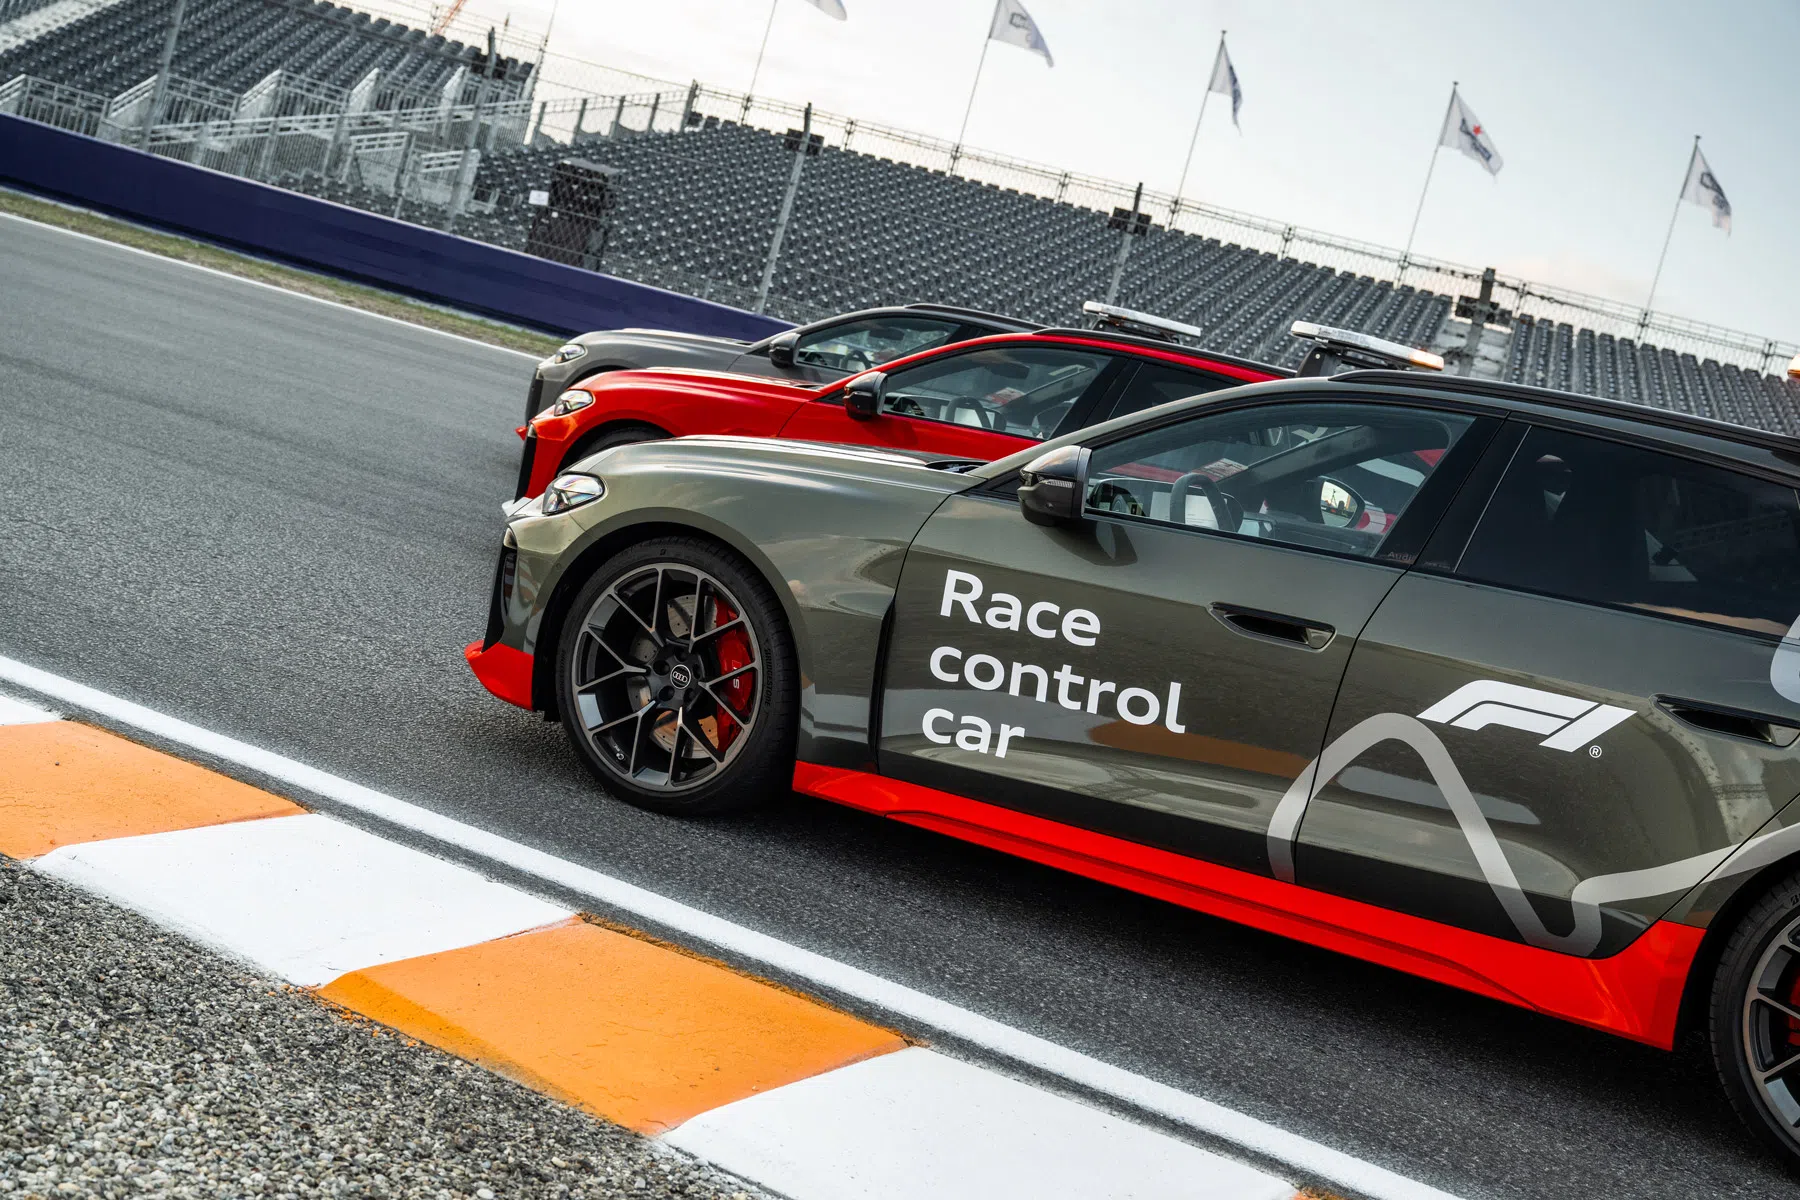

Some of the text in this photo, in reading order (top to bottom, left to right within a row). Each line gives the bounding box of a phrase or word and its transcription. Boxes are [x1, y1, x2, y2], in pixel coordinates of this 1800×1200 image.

[940, 569, 1101, 647] Race
[929, 646, 1186, 734] control
[1415, 679, 1638, 753] F1
[922, 708, 1026, 759] car
